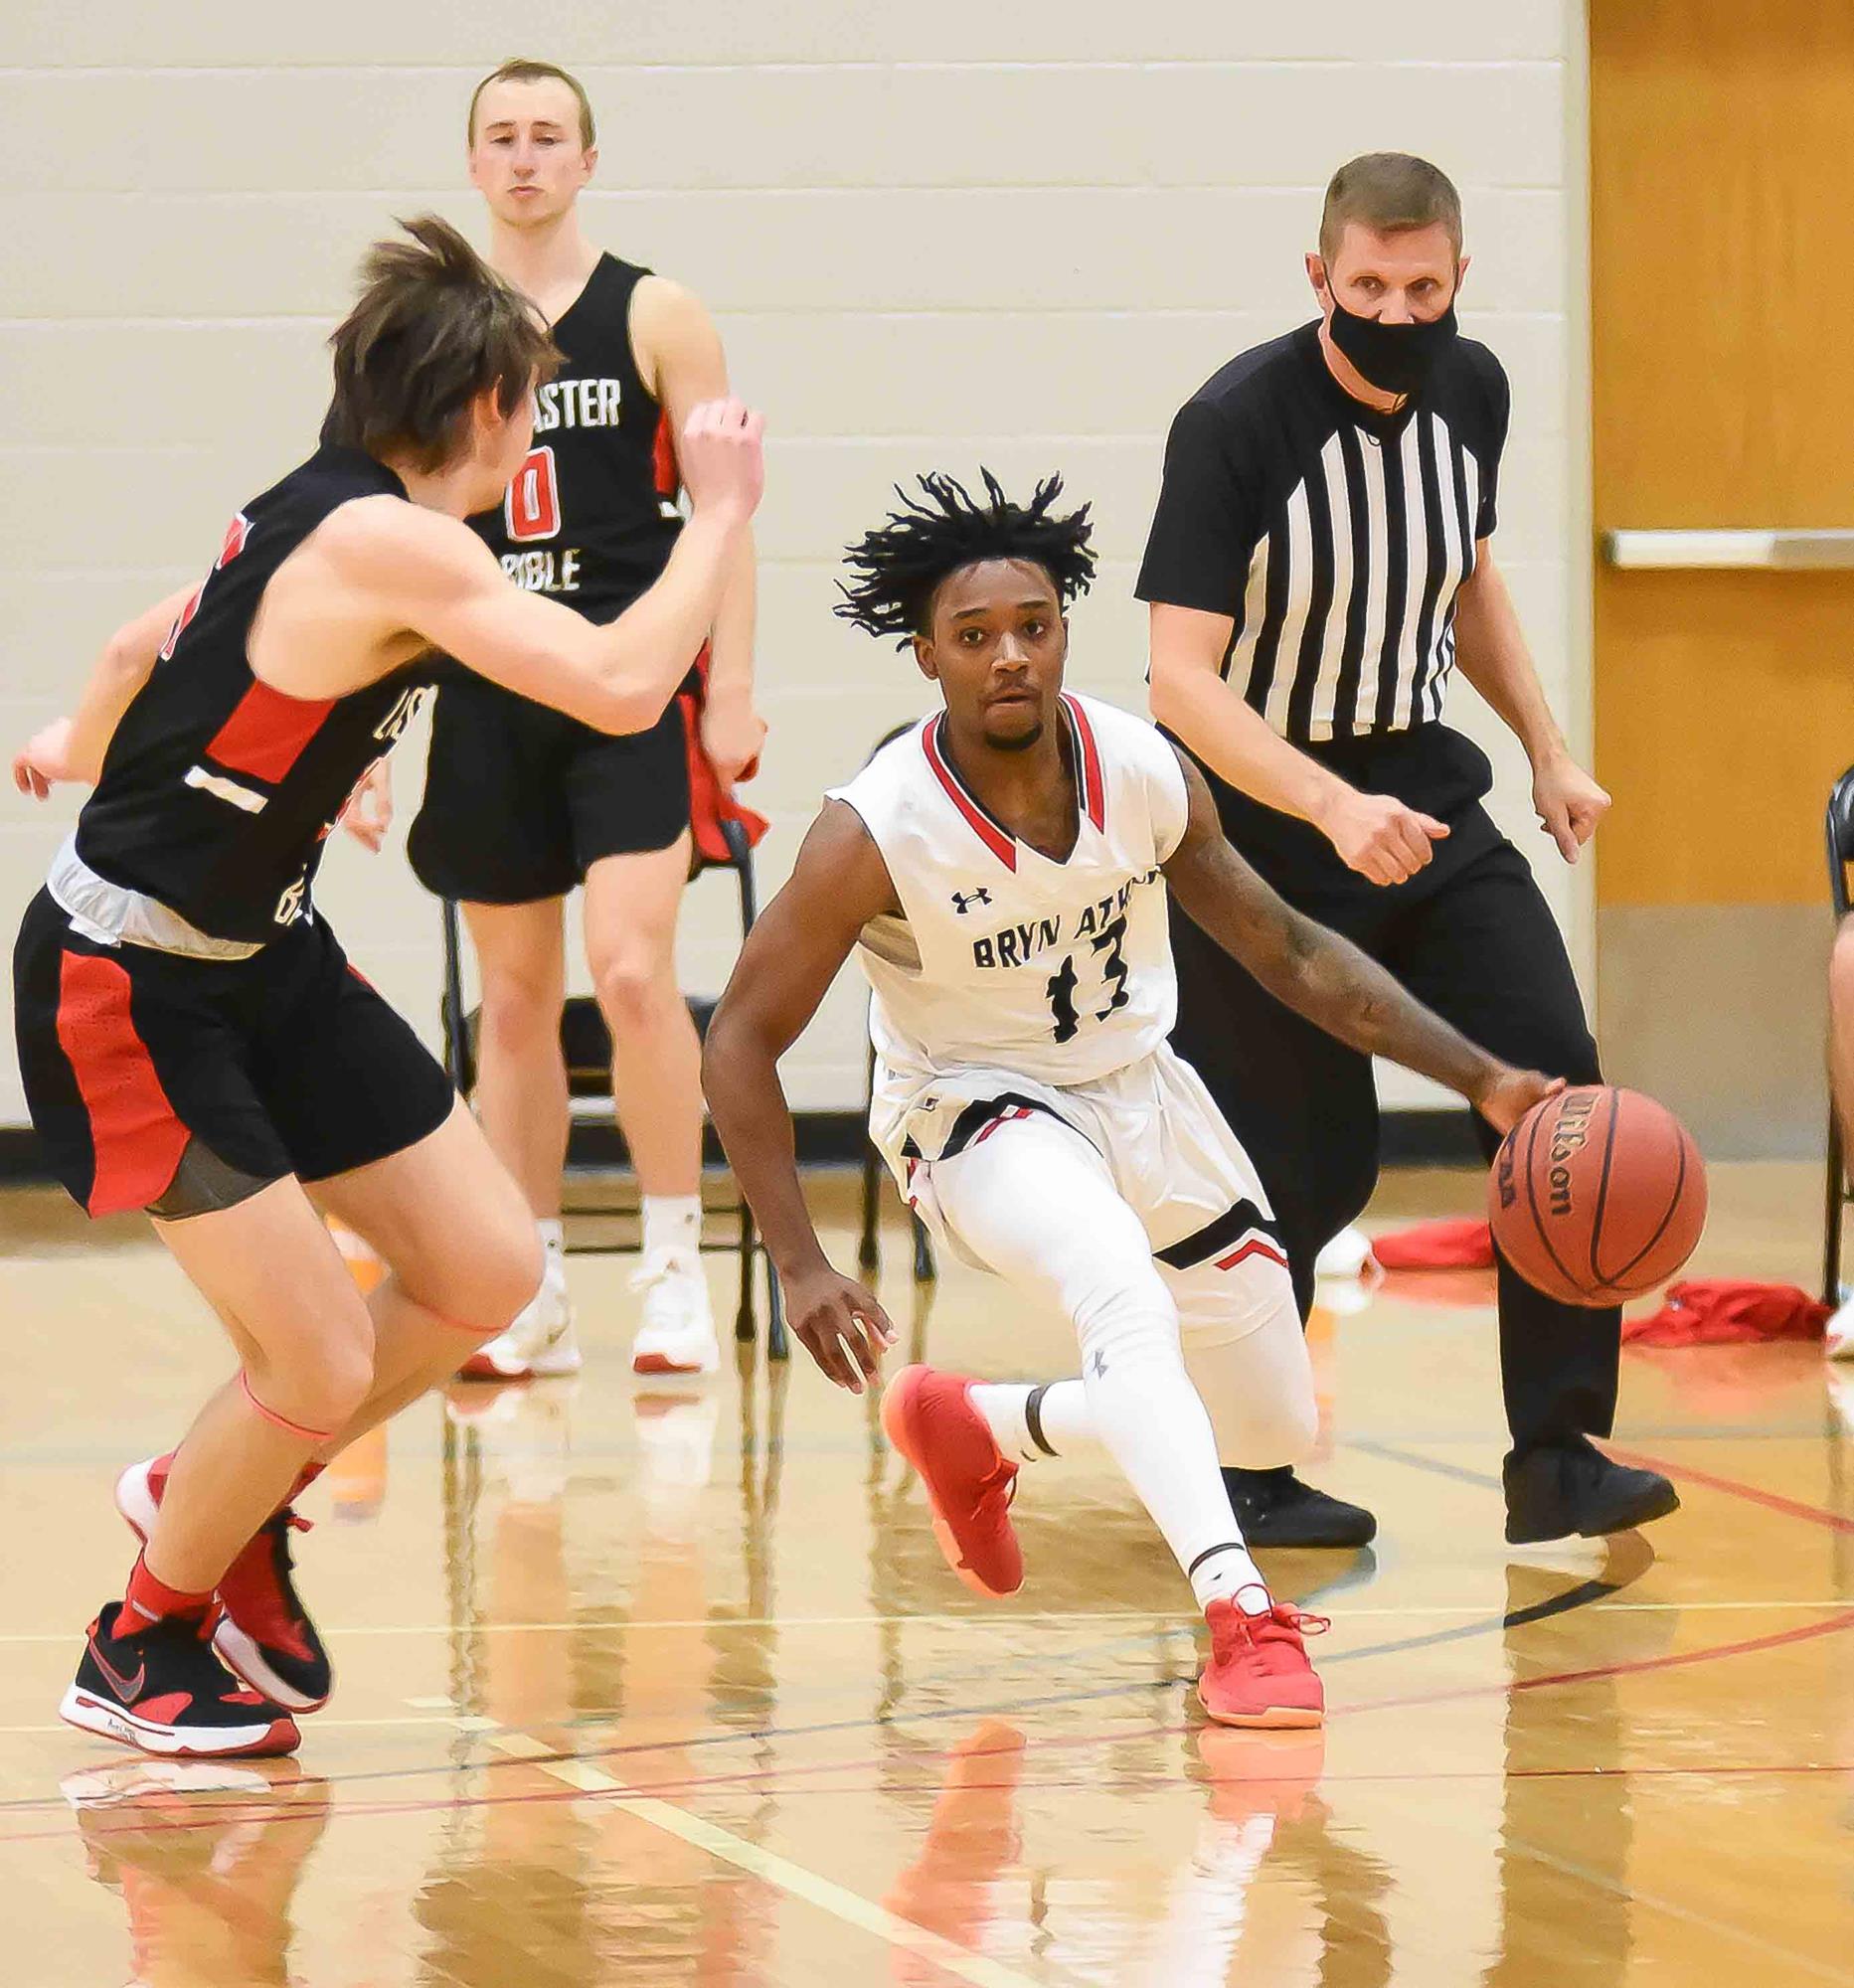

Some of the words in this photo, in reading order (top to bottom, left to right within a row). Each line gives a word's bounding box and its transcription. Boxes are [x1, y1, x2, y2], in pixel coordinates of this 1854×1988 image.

[504, 445, 562, 542] 0
[973, 914, 1061, 968] BRYN
[1047, 913, 1129, 1044] 13
